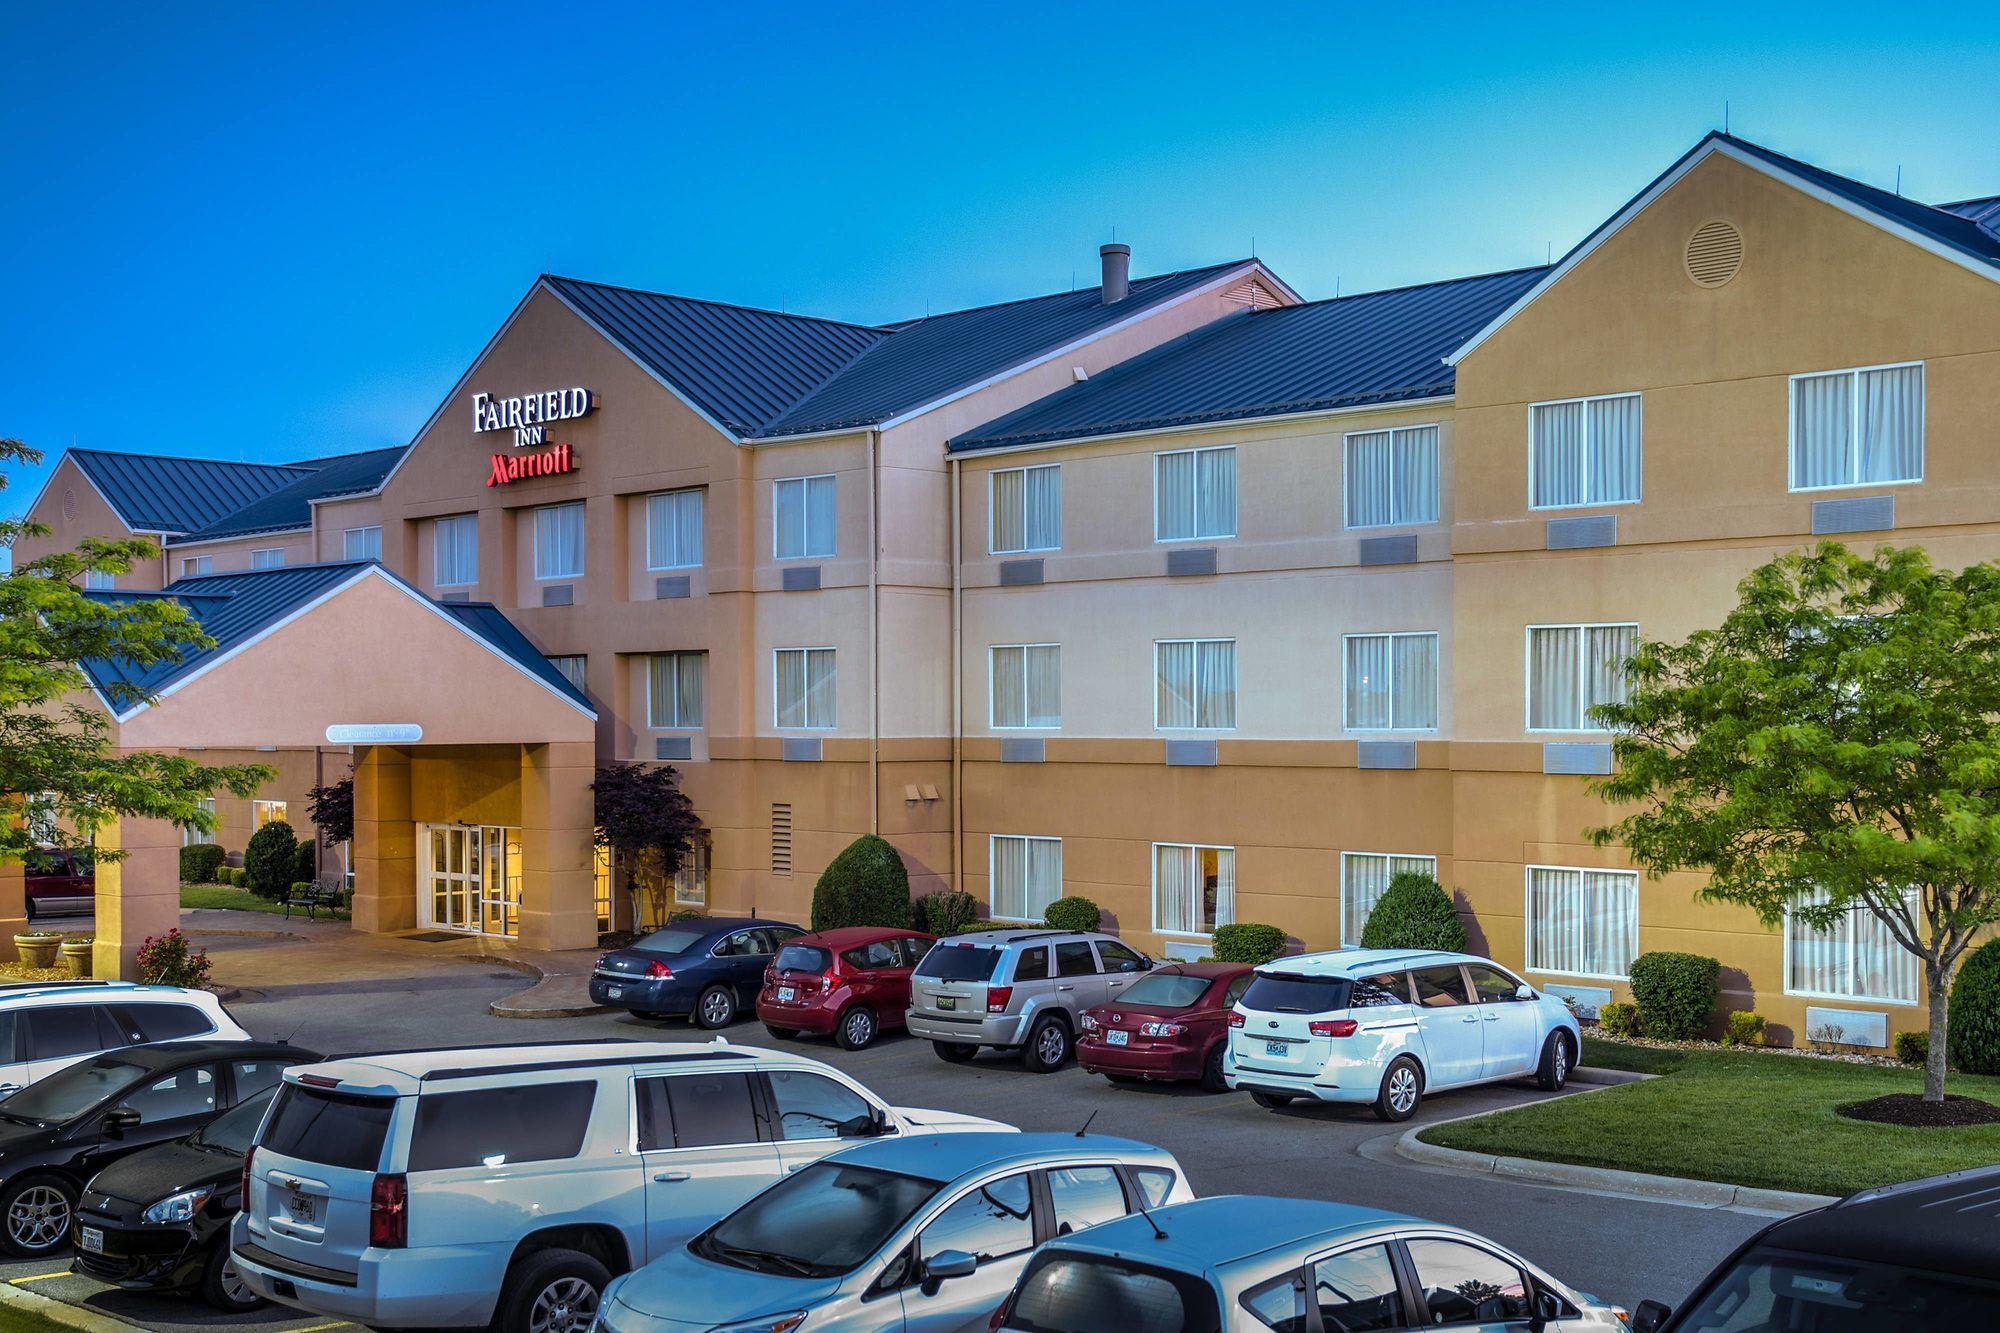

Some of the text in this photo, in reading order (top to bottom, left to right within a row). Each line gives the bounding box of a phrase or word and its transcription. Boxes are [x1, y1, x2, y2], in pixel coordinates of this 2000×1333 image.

[472, 387, 590, 433] FAIRFIELD
[514, 426, 544, 447] INN
[486, 444, 570, 487] Marriott
